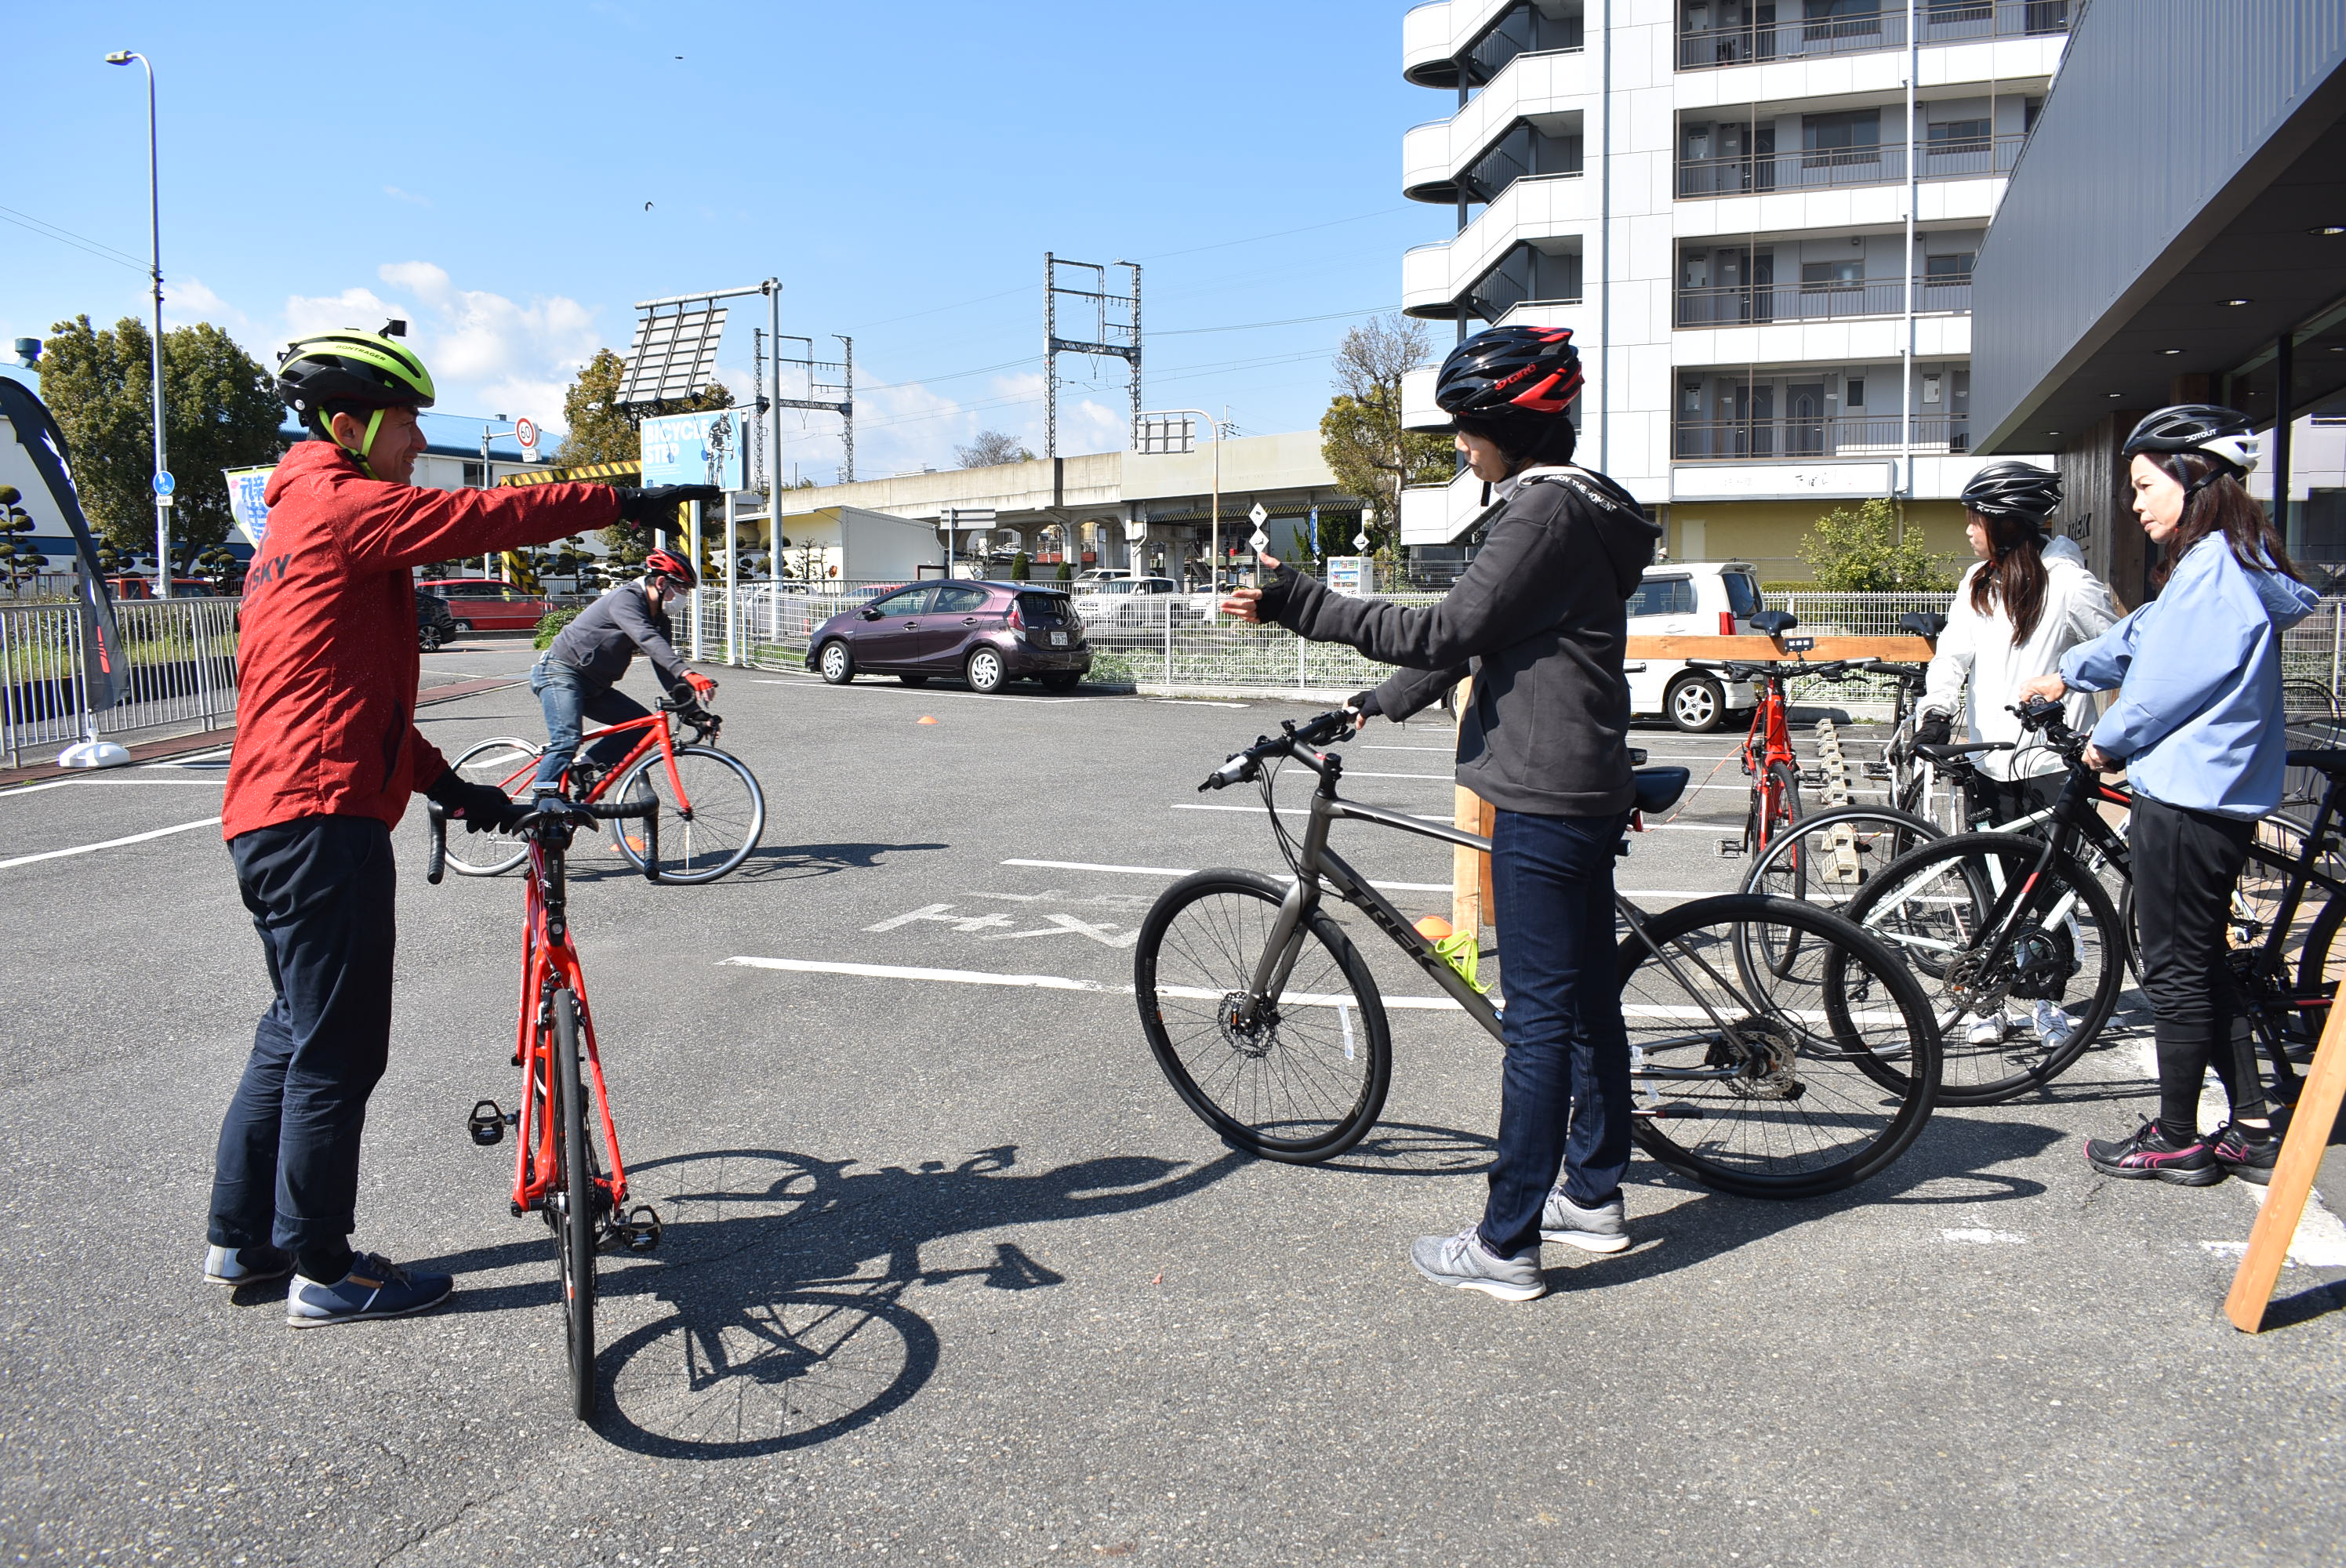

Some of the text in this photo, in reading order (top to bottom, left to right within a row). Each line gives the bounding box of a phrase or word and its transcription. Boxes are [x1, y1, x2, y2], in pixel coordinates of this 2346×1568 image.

[336, 344, 387, 361] BONTRAGER
[1508, 363, 1537, 384] GIRO
[521, 426, 531, 439] 60
[645, 419, 710, 445] BICYCLE
[2184, 429, 2217, 442] DOTOUT
[645, 442, 680, 464] STEP
[1572, 479, 1588, 494] THE
[1347, 879, 1441, 973] TREK
[1908, 1019, 1923, 1069] AFFINITY
